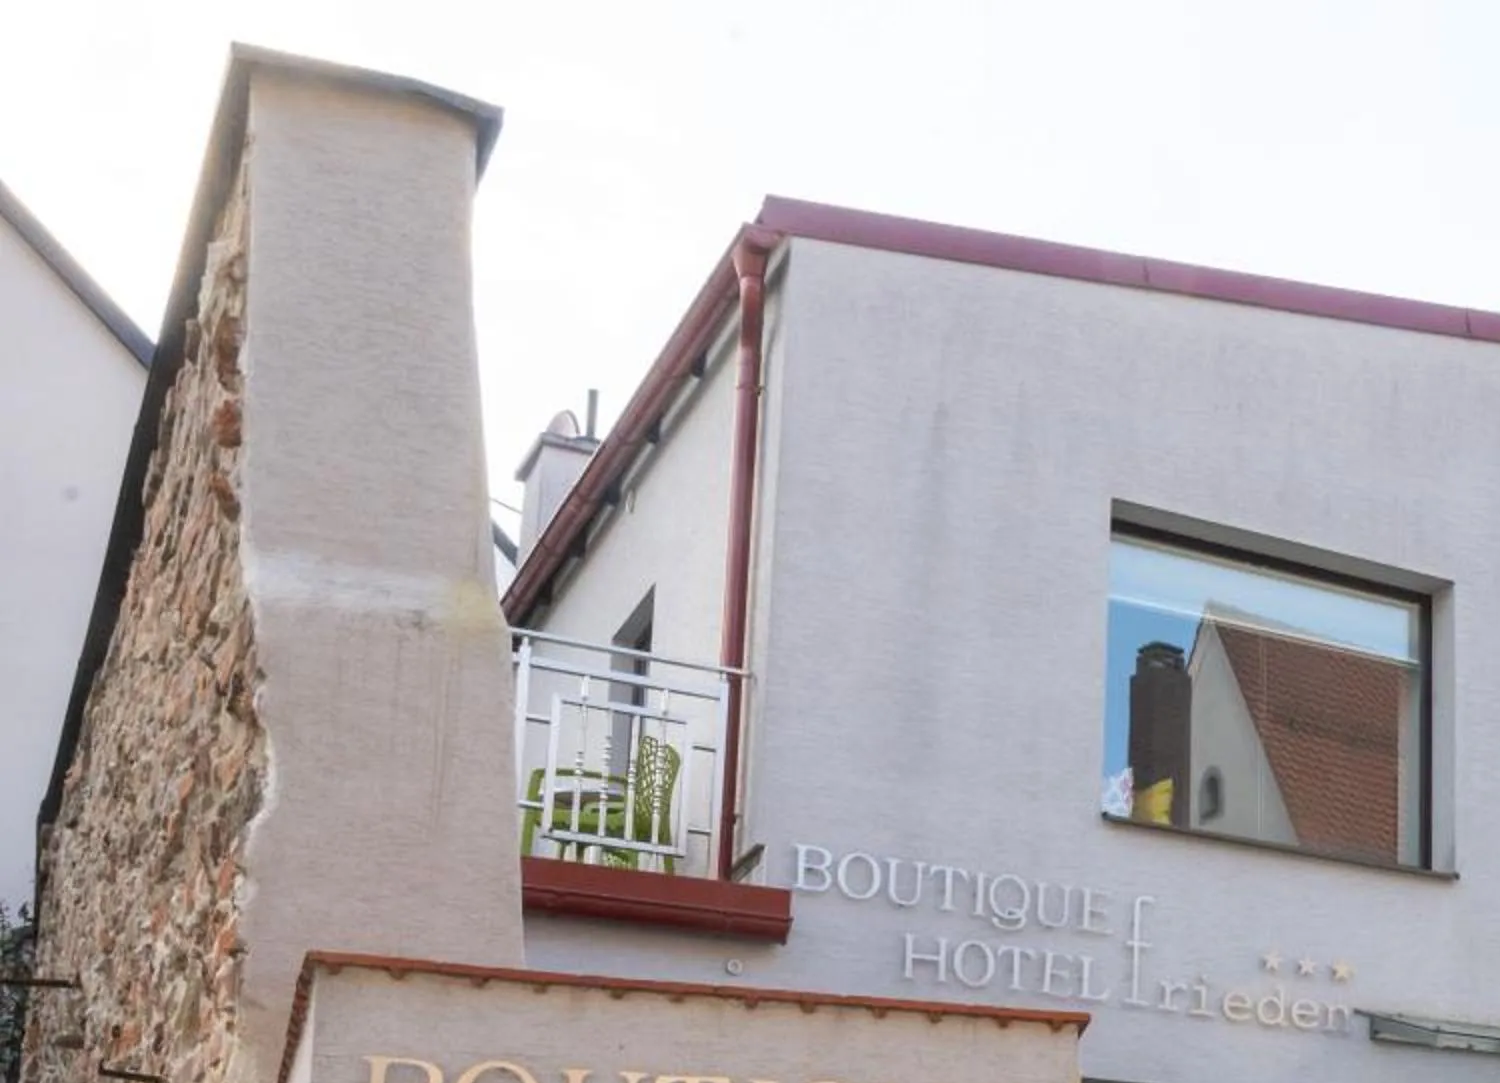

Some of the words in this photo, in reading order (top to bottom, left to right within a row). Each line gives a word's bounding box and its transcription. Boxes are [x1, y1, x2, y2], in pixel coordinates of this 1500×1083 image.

[793, 843, 1114, 930] BOUTIQUE
[902, 934, 1108, 1002] HOTEL
[1121, 894, 1355, 1031] frieden
